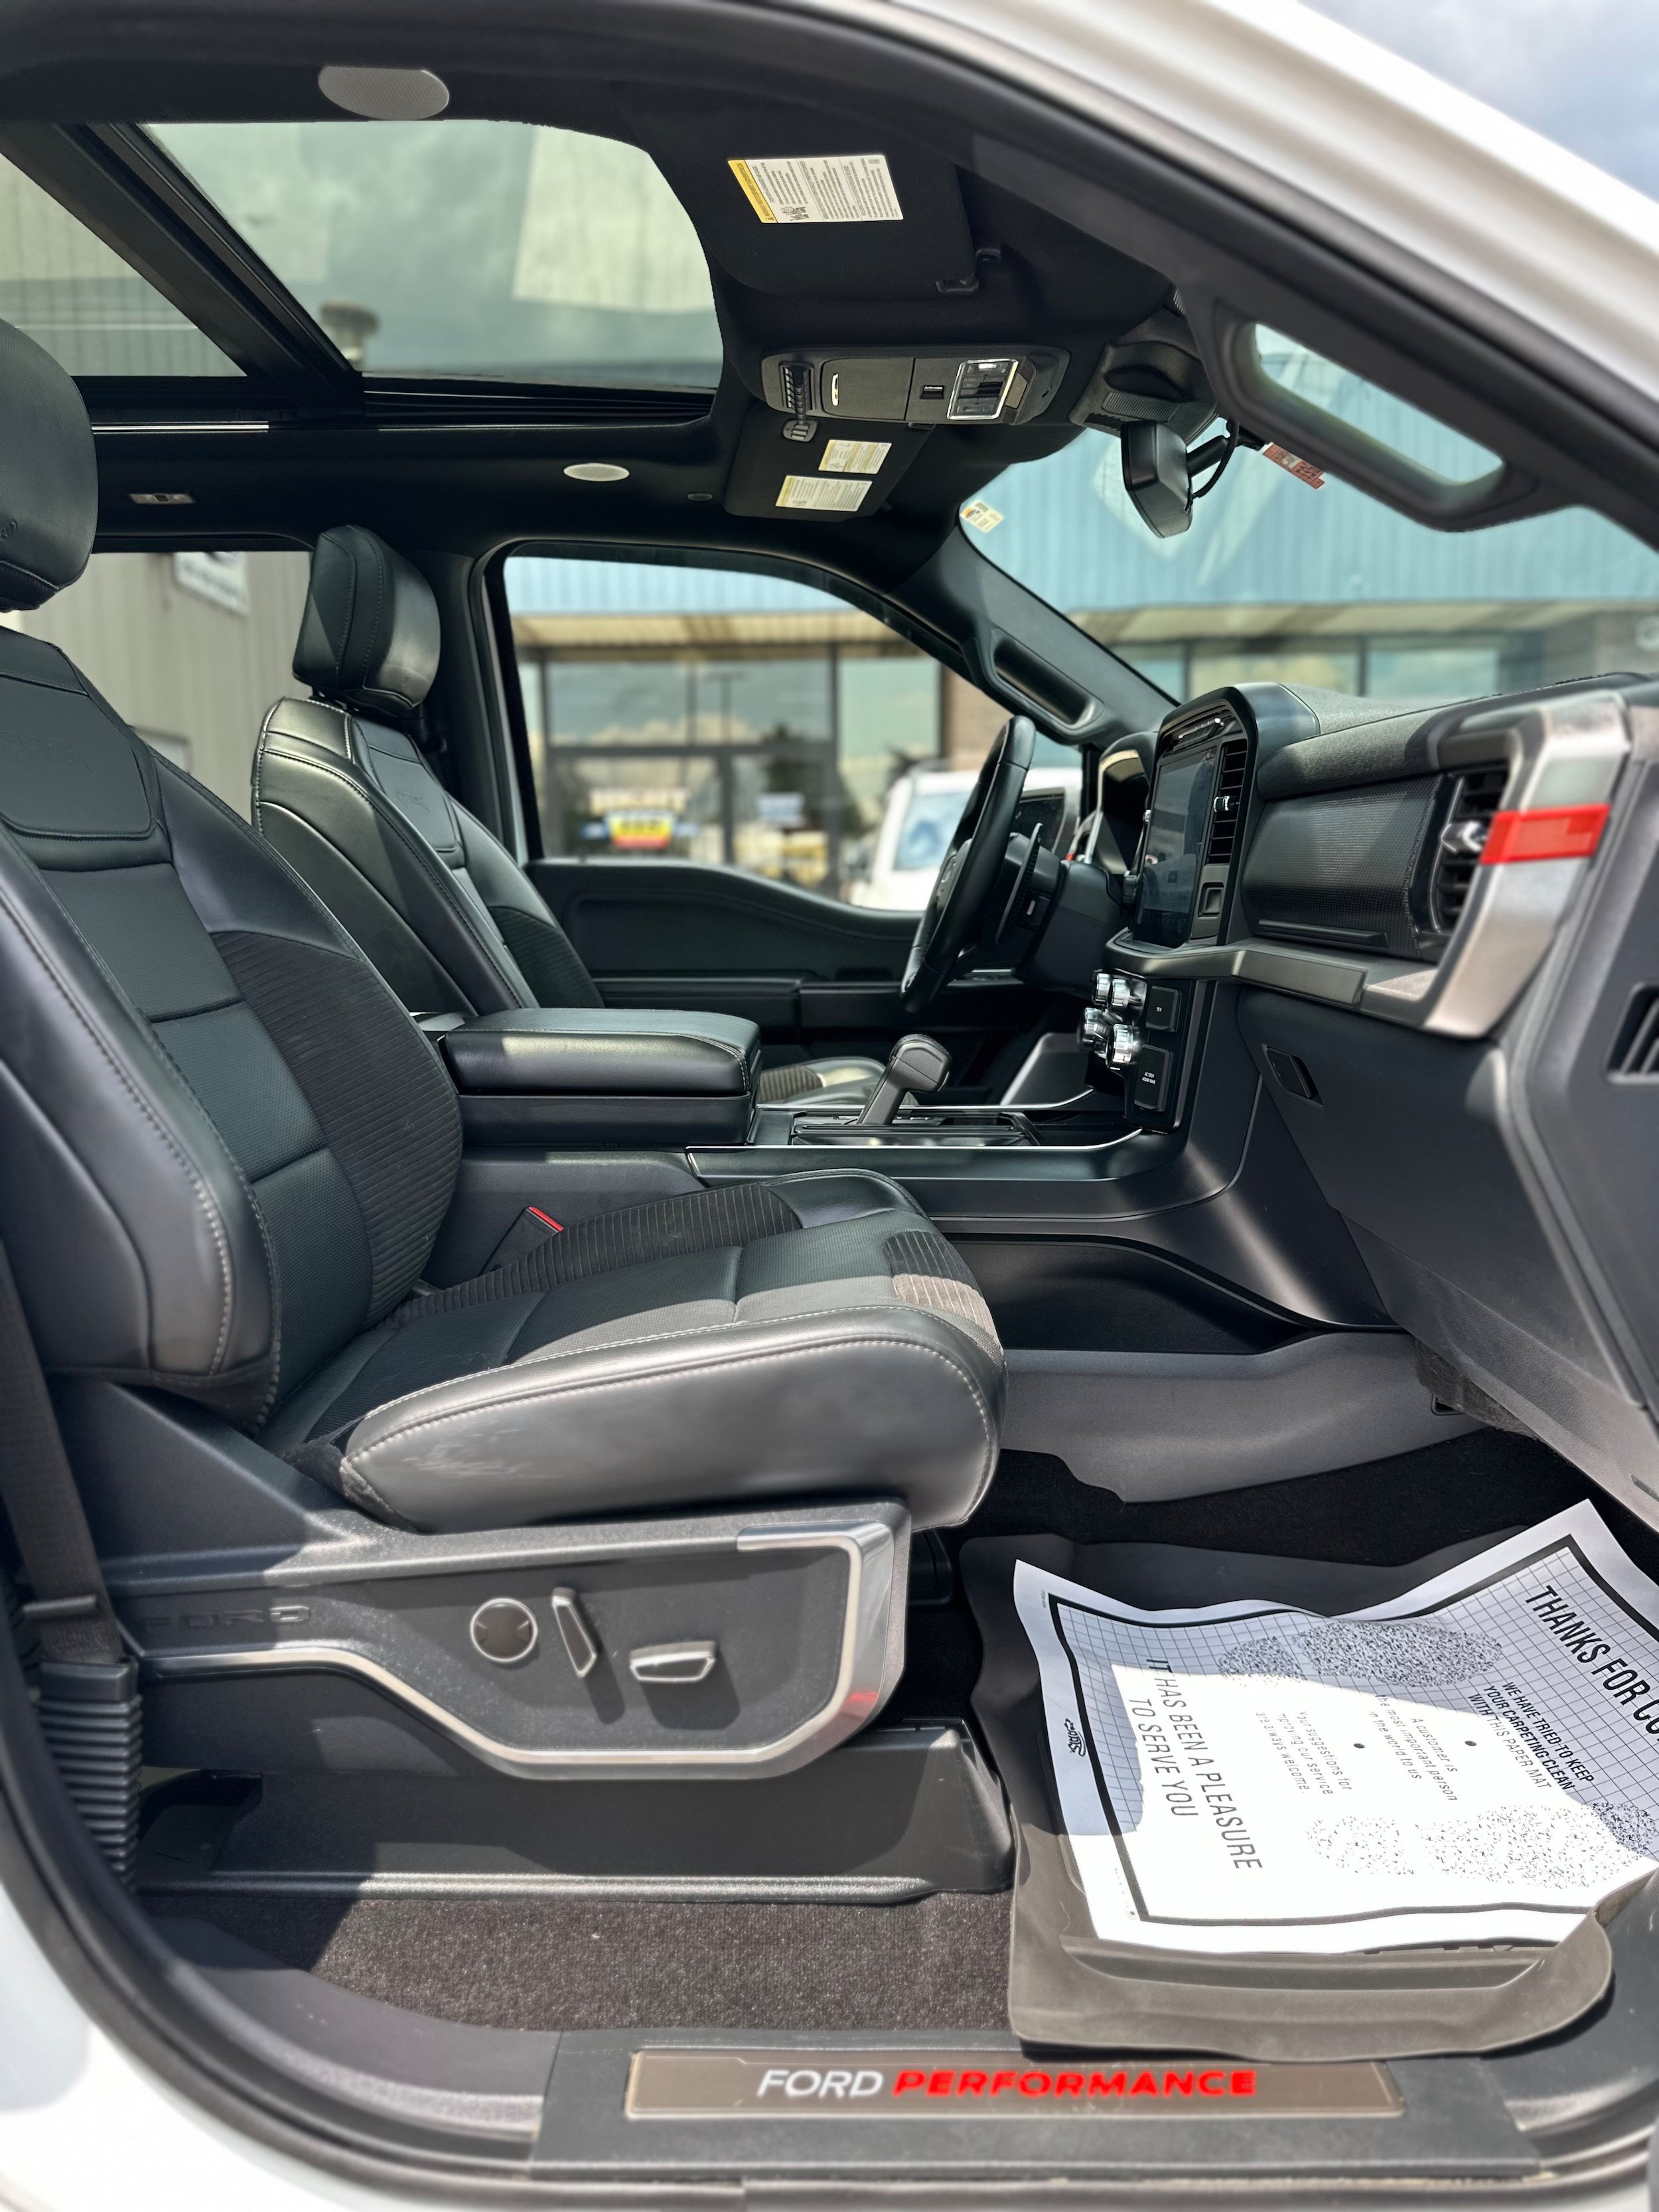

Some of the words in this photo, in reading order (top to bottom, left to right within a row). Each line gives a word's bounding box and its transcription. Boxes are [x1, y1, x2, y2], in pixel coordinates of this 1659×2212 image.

[145, 1604, 311, 1628] FORD
[1146, 1659, 1173, 1673] IT
[1525, 1585, 1611, 1663] THANKS
[1591, 1658, 1651, 1706] FOR
[1129, 1698, 1156, 1717] TO
[1154, 1678, 1187, 1708] HAS
[1137, 1724, 1181, 1774] SERVE
[1169, 1714, 1208, 1750] BEEN
[1374, 1720, 1388, 1732] the
[1384, 1734, 1406, 1756] world
[1387, 1710, 1406, 1727] most
[1401, 1730, 1435, 1769] important
[1429, 1769, 1458, 1801] person
[1416, 1725, 1449, 1761] customer
[1445, 1764, 1458, 1773] is
[1469, 1694, 1493, 1716] WITH
[1487, 1716, 1510, 1737] THIS
[1503, 1738, 1534, 1767] PAPER
[1526, 1770, 1552, 1789] MAT
[1484, 1686, 1510, 1710] YOUR
[1503, 1710, 1548, 1759] CARPETING
[1542, 1759, 1575, 1790] CLEAN
[1502, 1682, 1522, 1696] WE
[1514, 1694, 1540, 1718] HAVE
[1533, 1718, 1561, 1745] TRIED
[1555, 1745, 1573, 1759] TO
[1565, 1757, 1594, 1782] KEEP
[1188, 1757, 1214, 1767] A
[1298, 1747, 1313, 1761] our
[1307, 1763, 1333, 1795] service
[1306, 1728, 1342, 1776] suggestions
[1338, 1779, 1352, 1791] for
[1161, 1780, 1198, 1816] YOU
[1196, 1773, 1263, 1869] PLEASURE
[756, 2068, 884, 2099] FORD
[893, 2069, 1259, 2099] PERFORMANCE
